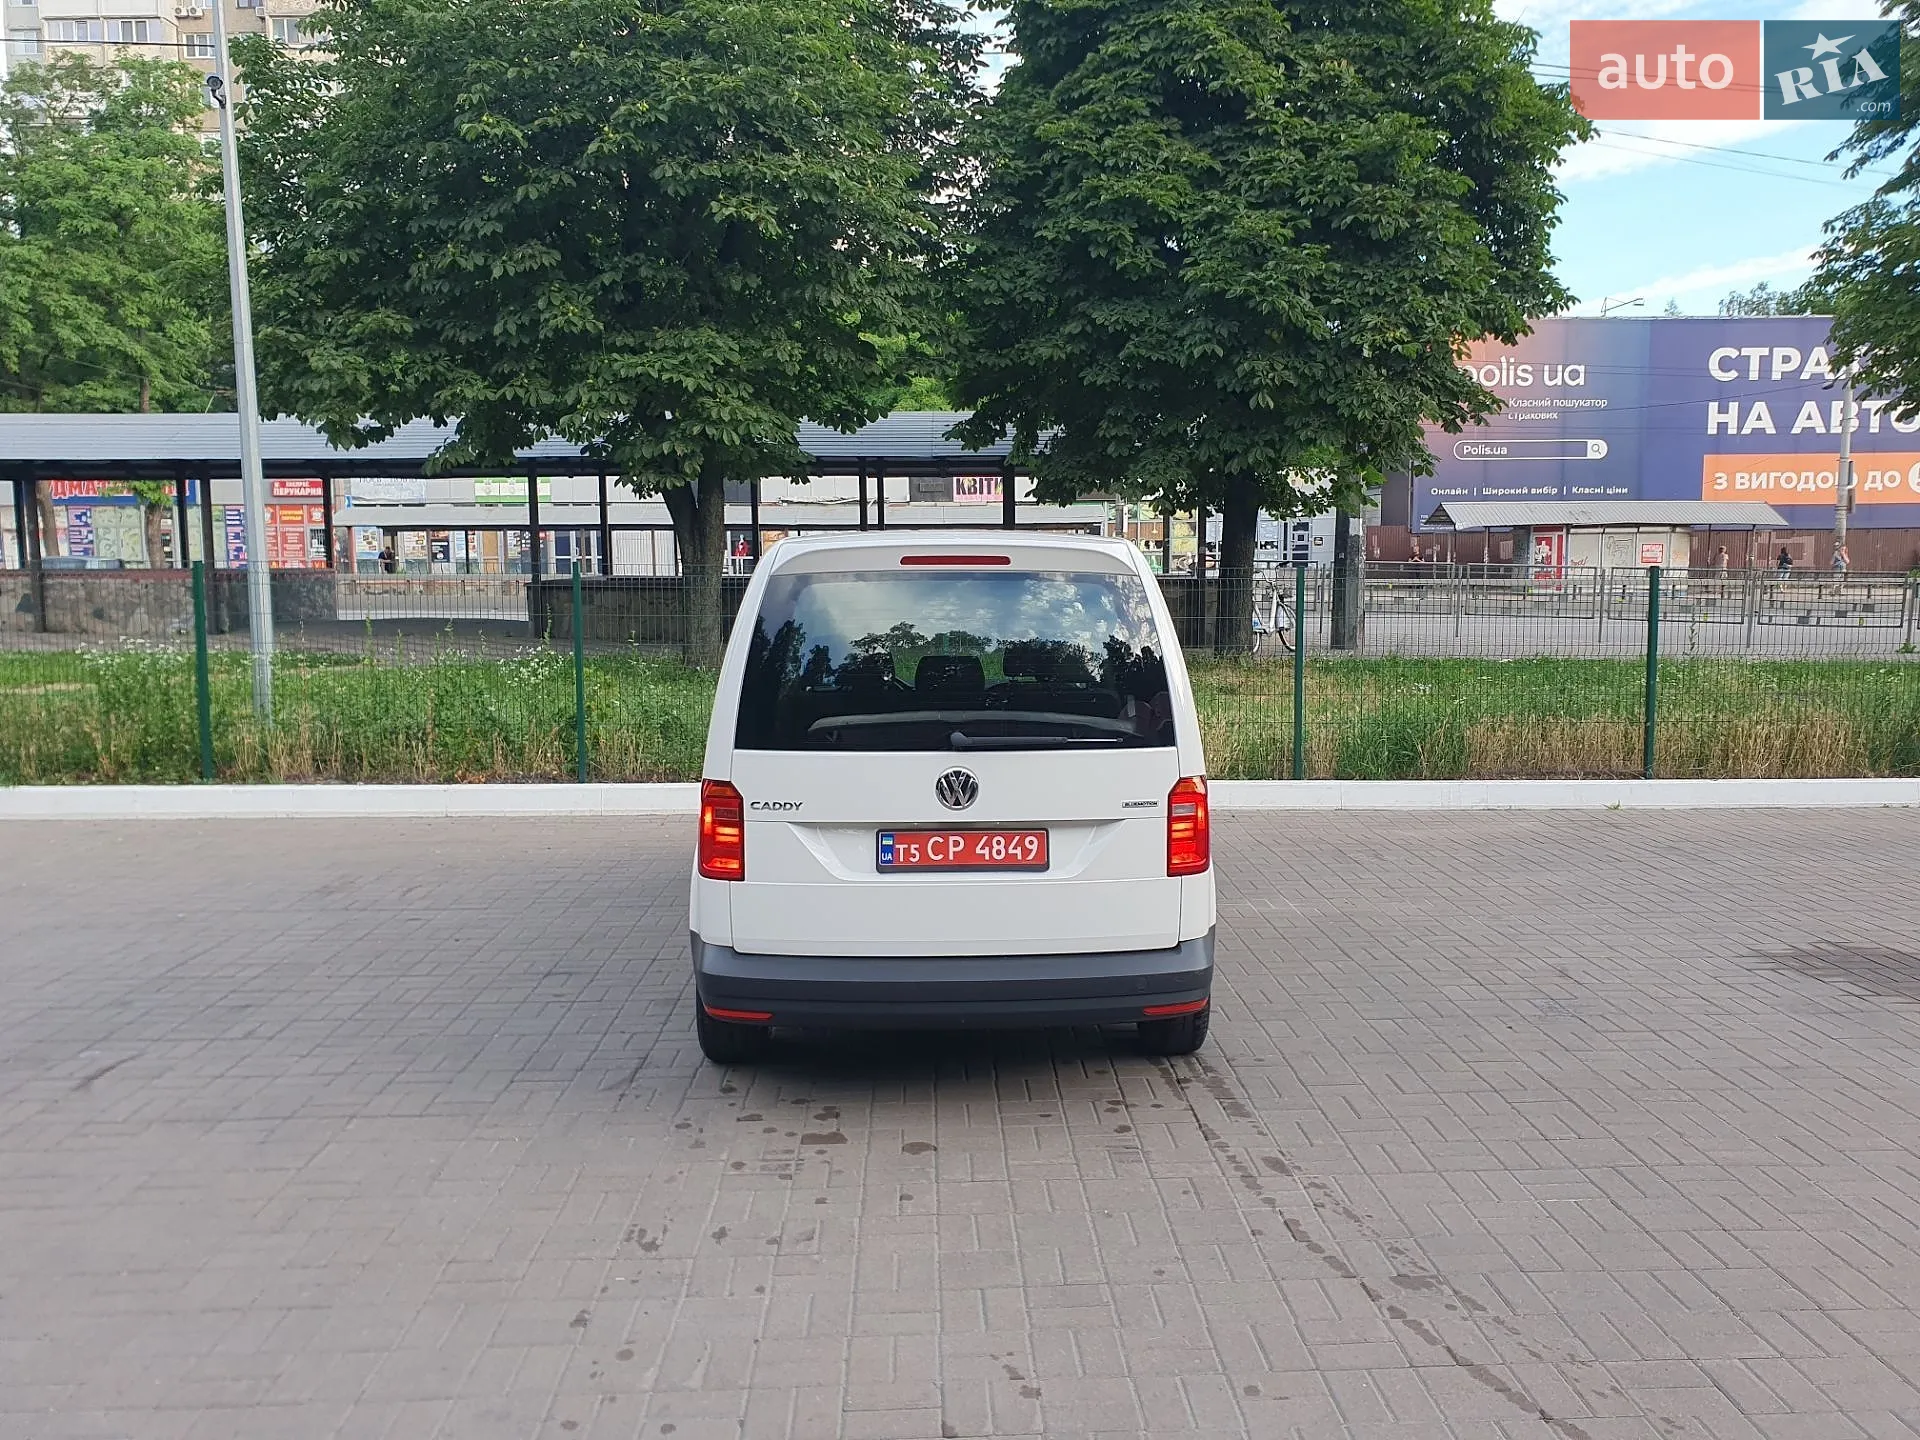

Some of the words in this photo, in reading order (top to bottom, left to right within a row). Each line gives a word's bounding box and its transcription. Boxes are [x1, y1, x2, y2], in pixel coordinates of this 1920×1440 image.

[1543, 364, 1585, 387] ua
[1508, 397, 1551, 408] Класний
[1552, 398, 1608, 411] пошукатор
[1508, 412, 1559, 421] страхових
[1707, 401, 1777, 435] НА
[1463, 444, 1507, 455] Polis.ua
[1863, 470, 1902, 491] ДО
[1431, 486, 1468, 495] Онлайн
[1482, 486, 1528, 496] Широкий
[1531, 486, 1558, 496] вибір
[1572, 486, 1604, 494] Класні
[1606, 486, 1629, 495] ціни
[750, 801, 803, 811] CADDY
[896, 844, 921, 863] T5
[927, 836, 965, 861] CP
[975, 836, 1039, 861] 4849
[881, 852, 893, 861] UA
